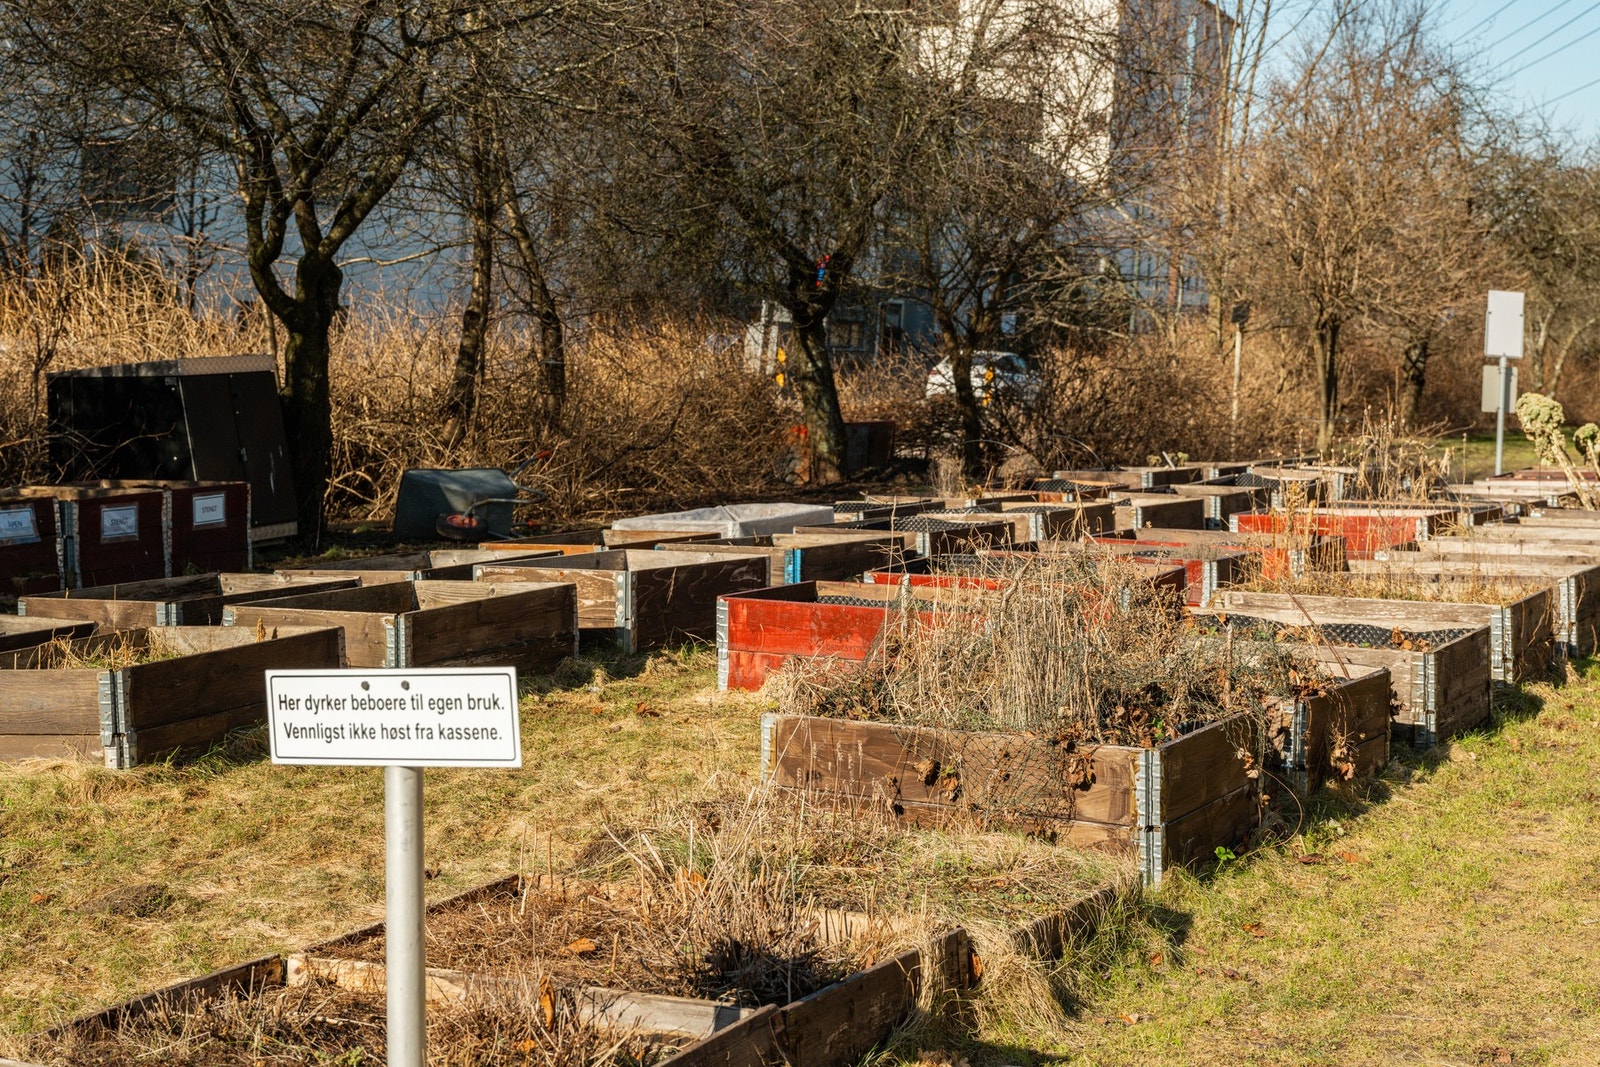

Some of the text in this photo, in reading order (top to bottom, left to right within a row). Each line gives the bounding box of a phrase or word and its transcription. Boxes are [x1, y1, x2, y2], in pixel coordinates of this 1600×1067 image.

[200, 505, 218, 514] STENGT
[110, 517, 129, 527] STENGT
[278, 693, 505, 715] Her dyrker beboere til egen bruk.
[283, 722, 503, 744] Vennligst ikke høst fra kassene.
